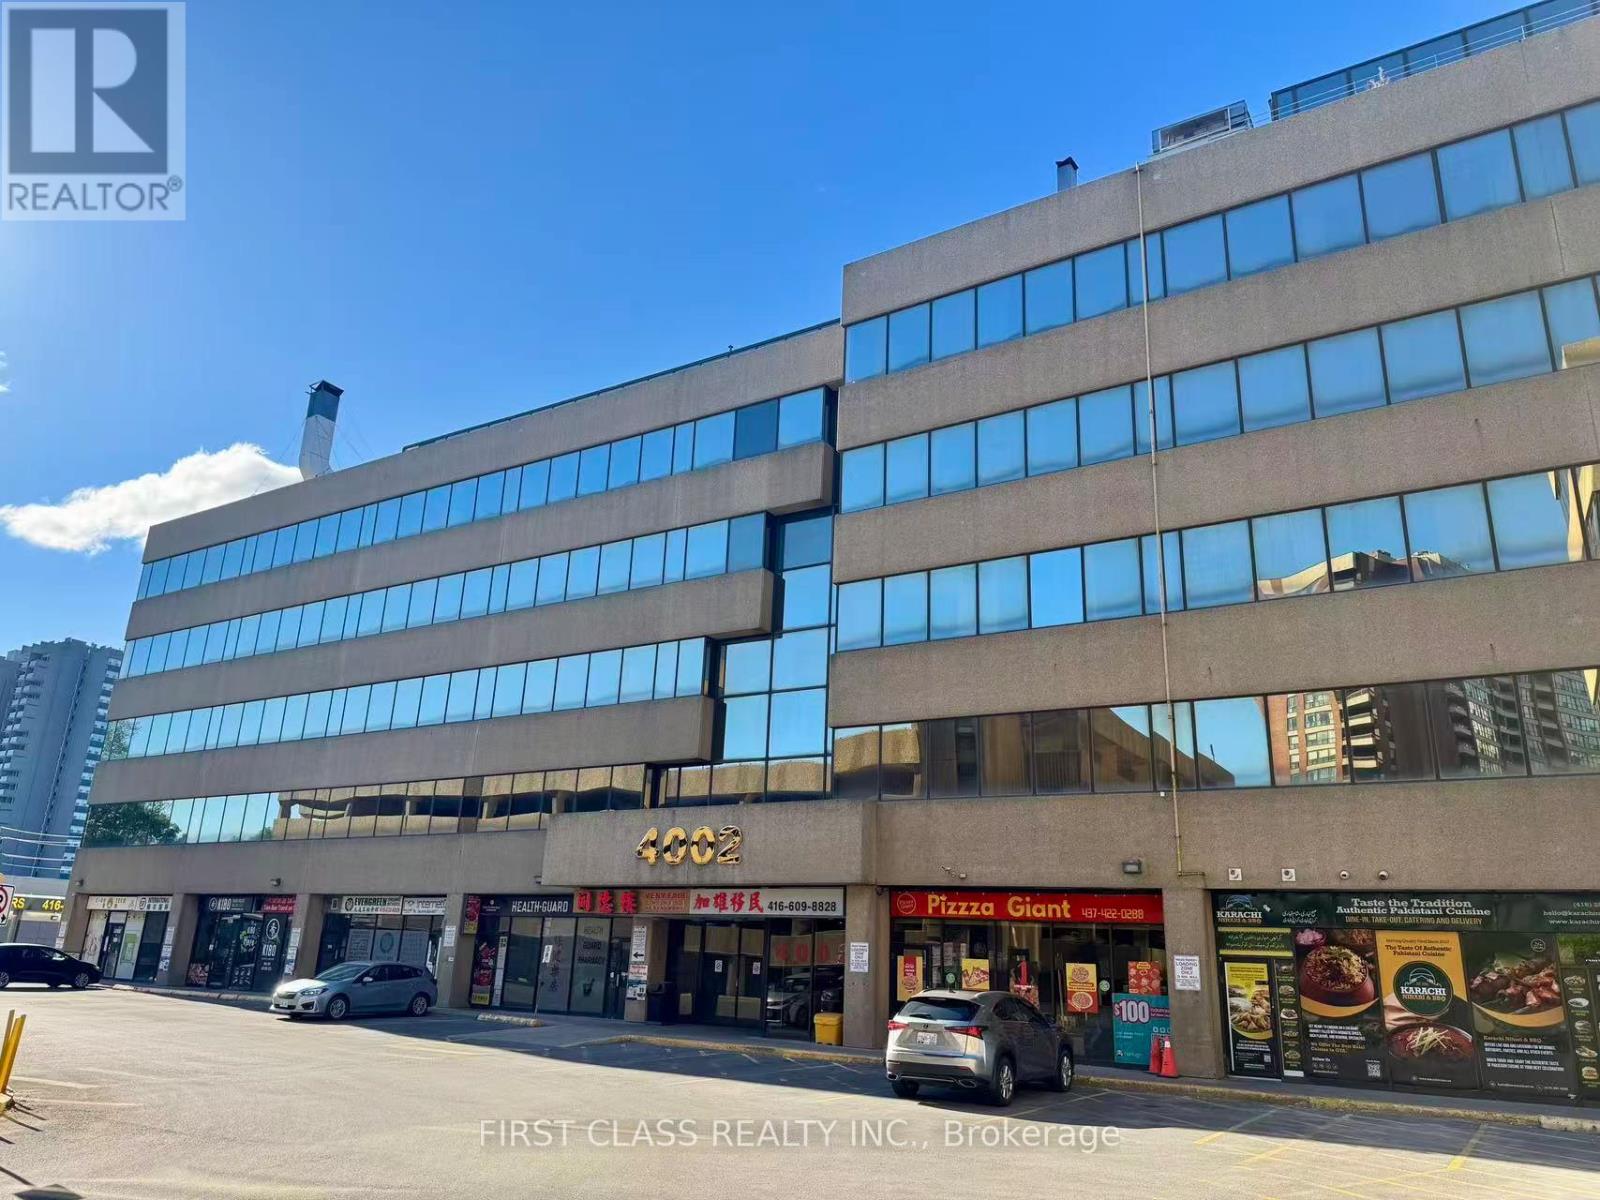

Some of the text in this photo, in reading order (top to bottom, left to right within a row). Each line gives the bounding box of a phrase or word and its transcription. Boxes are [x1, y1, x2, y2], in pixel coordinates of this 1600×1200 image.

[635, 825, 743, 865] 4002
[354, 897, 388, 906] EVERGREEN
[693, 891, 764, 913] 加雄移民
[767, 900, 837, 912] 416-609-8828
[927, 894, 995, 916] Pizzza
[1007, 896, 1071, 918] Giant
[1081, 908, 1144, 919] 437-422-0288
[1351, 898, 1472, 908] Taste the Tradition
[1336, 906, 1491, 916] Authentic Pakistani Cuisine
[1451, 917, 1482, 925] DELIVERY
[1400, 986, 1446, 996] KARACHI
[1114, 1000, 1149, 1023] $100
